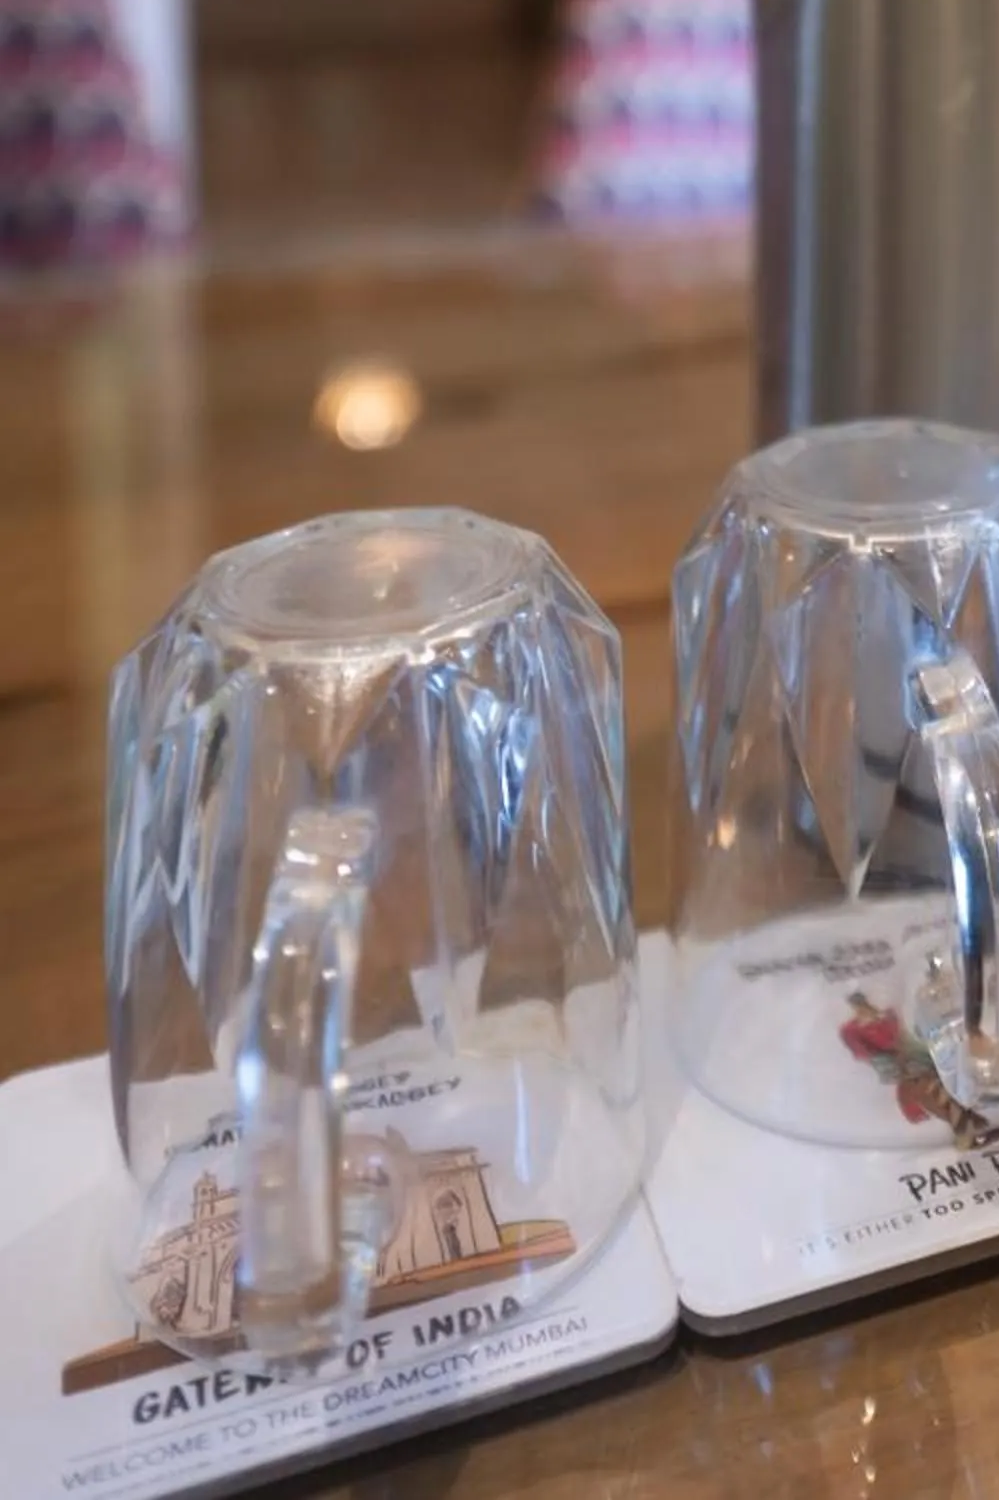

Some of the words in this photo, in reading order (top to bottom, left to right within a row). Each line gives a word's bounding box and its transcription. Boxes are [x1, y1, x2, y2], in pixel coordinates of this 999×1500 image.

[898, 1161, 976, 1202] PANI
[921, 1200, 964, 1219] TOO
[132, 1348, 328, 1425] GATE
[346, 1330, 394, 1368] OF
[412, 1296, 523, 1347] INDIA
[62, 1431, 210, 1492] WELCOME
[219, 1417, 258, 1443] TO
[265, 1401, 316, 1429] THE
[322, 1349, 480, 1412] DREAMCITY
[484, 1316, 589, 1360] MUMBAI
